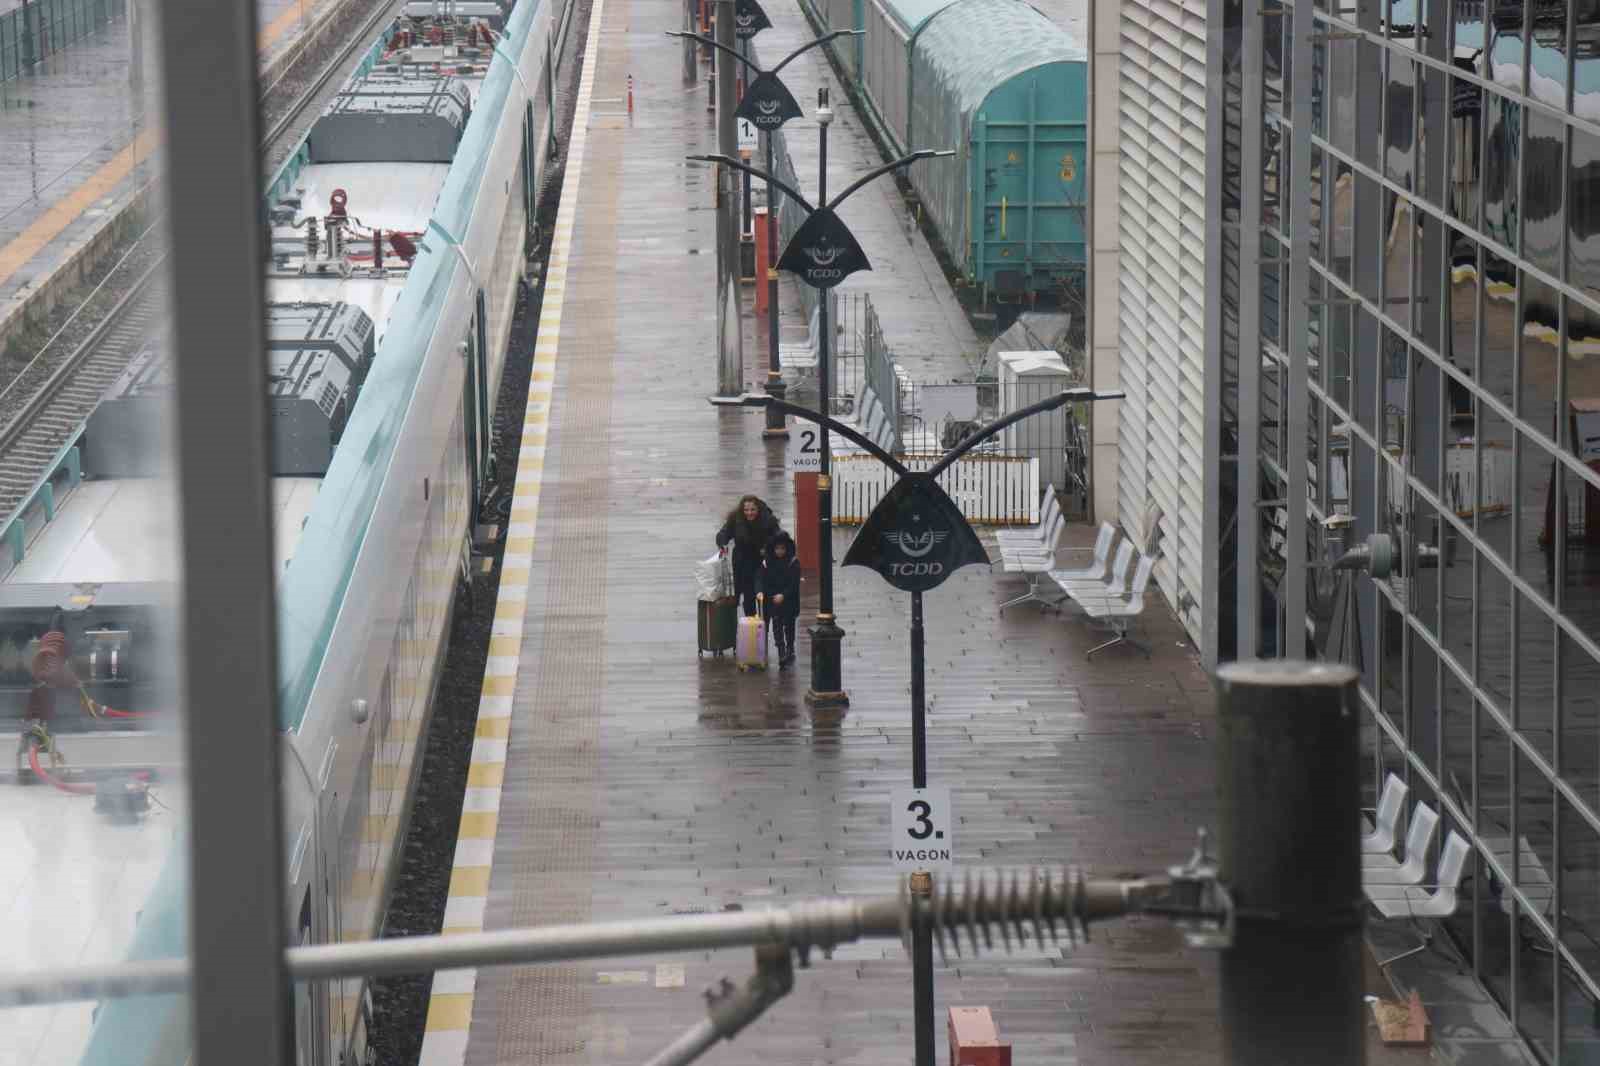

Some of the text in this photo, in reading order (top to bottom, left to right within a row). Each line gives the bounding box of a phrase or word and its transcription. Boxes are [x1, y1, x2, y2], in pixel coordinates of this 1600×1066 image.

[756, 116, 781, 124] TCDD
[741, 121, 753, 137] 1.
[807, 268, 841, 278] TCDD
[800, 430, 821, 453] 2.
[889, 562, 944, 576] TCDD
[907, 800, 944, 840] 3.
[896, 849, 950, 861] VAGON
